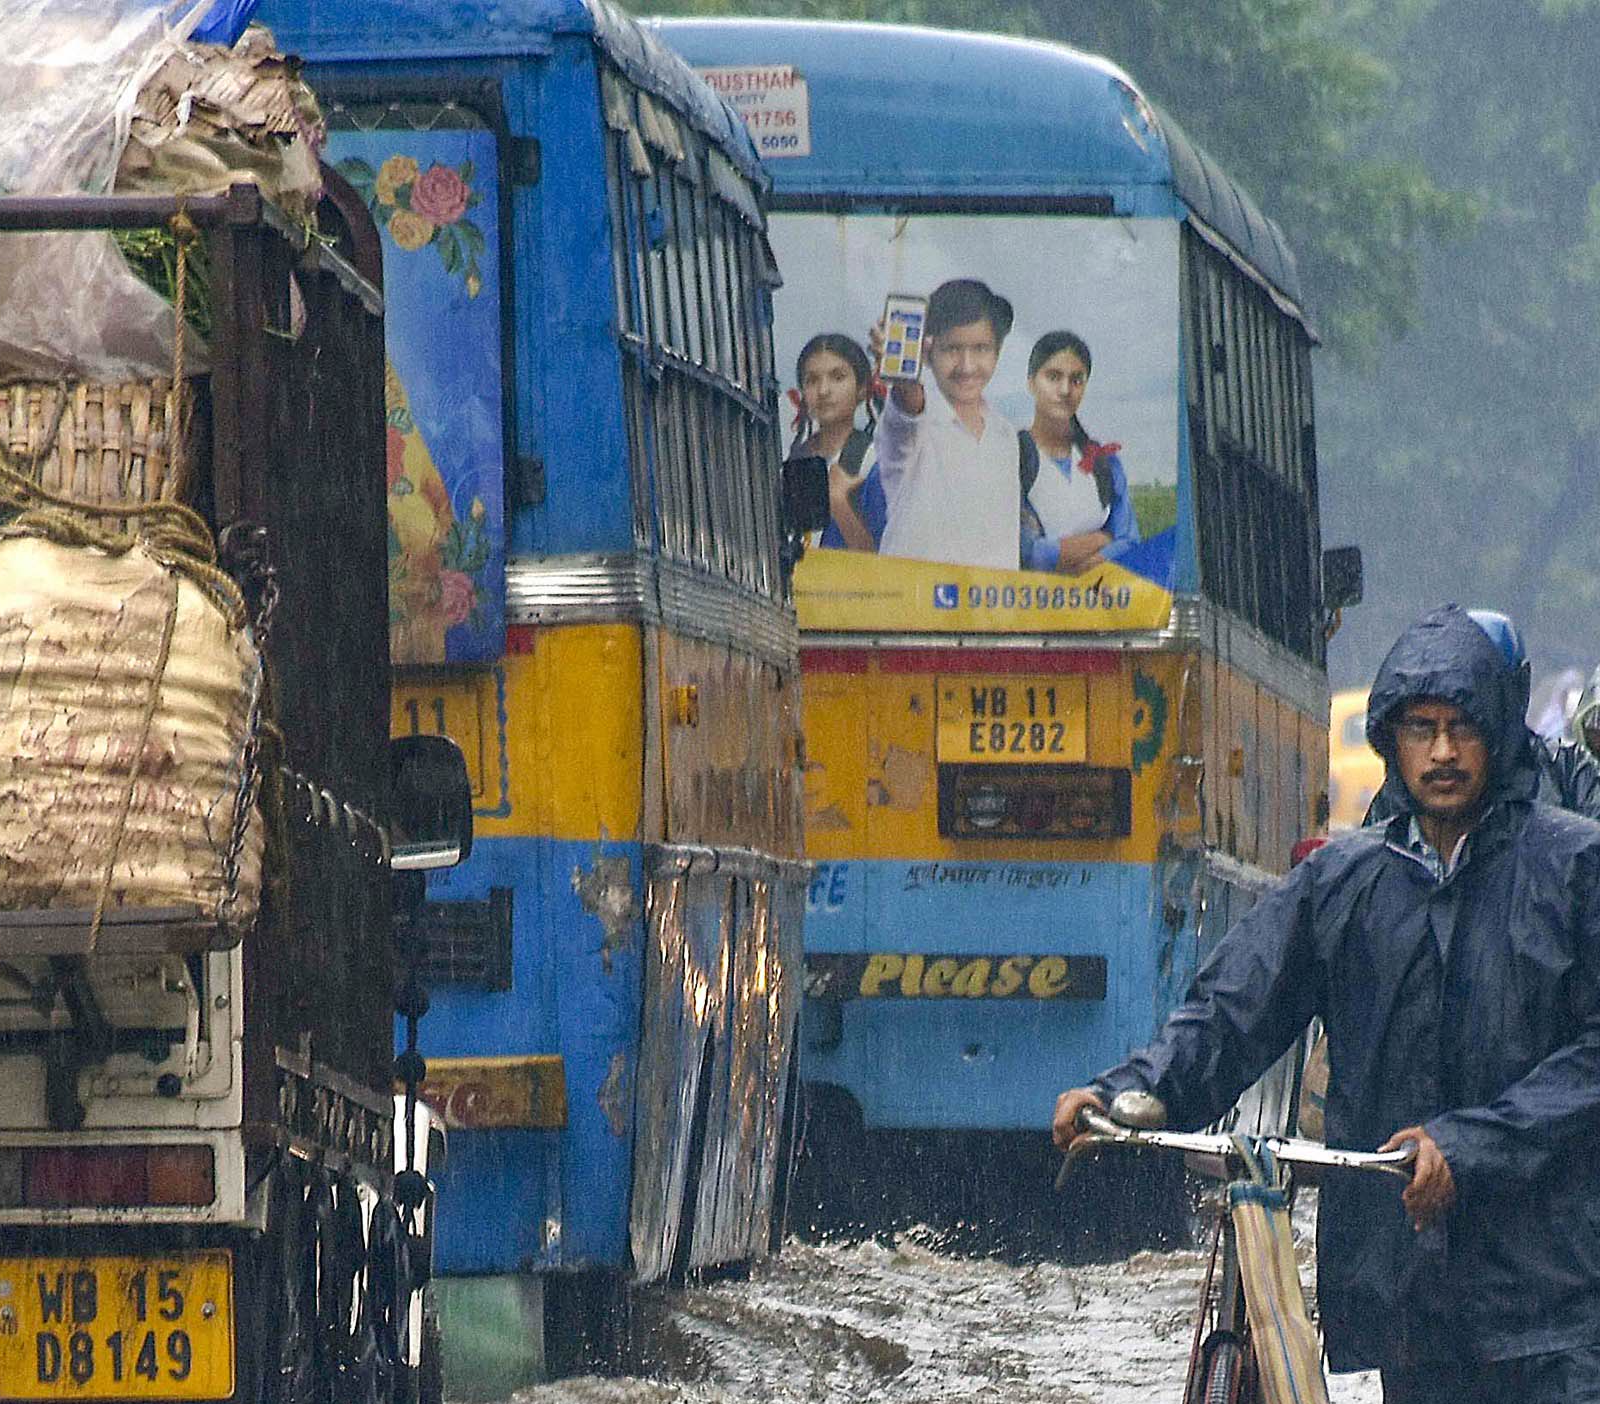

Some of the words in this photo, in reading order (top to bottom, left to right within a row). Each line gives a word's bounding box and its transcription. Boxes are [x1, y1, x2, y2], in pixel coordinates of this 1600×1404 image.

[761, 135, 799, 150] 5050
[970, 686, 1007, 718] WB
[1026, 686, 1057, 717] 11
[859, 953, 1070, 999] Please
[37, 1269, 98, 1325] WB
[127, 1269, 185, 1323] 15
[35, 1328, 194, 1386] D8149
